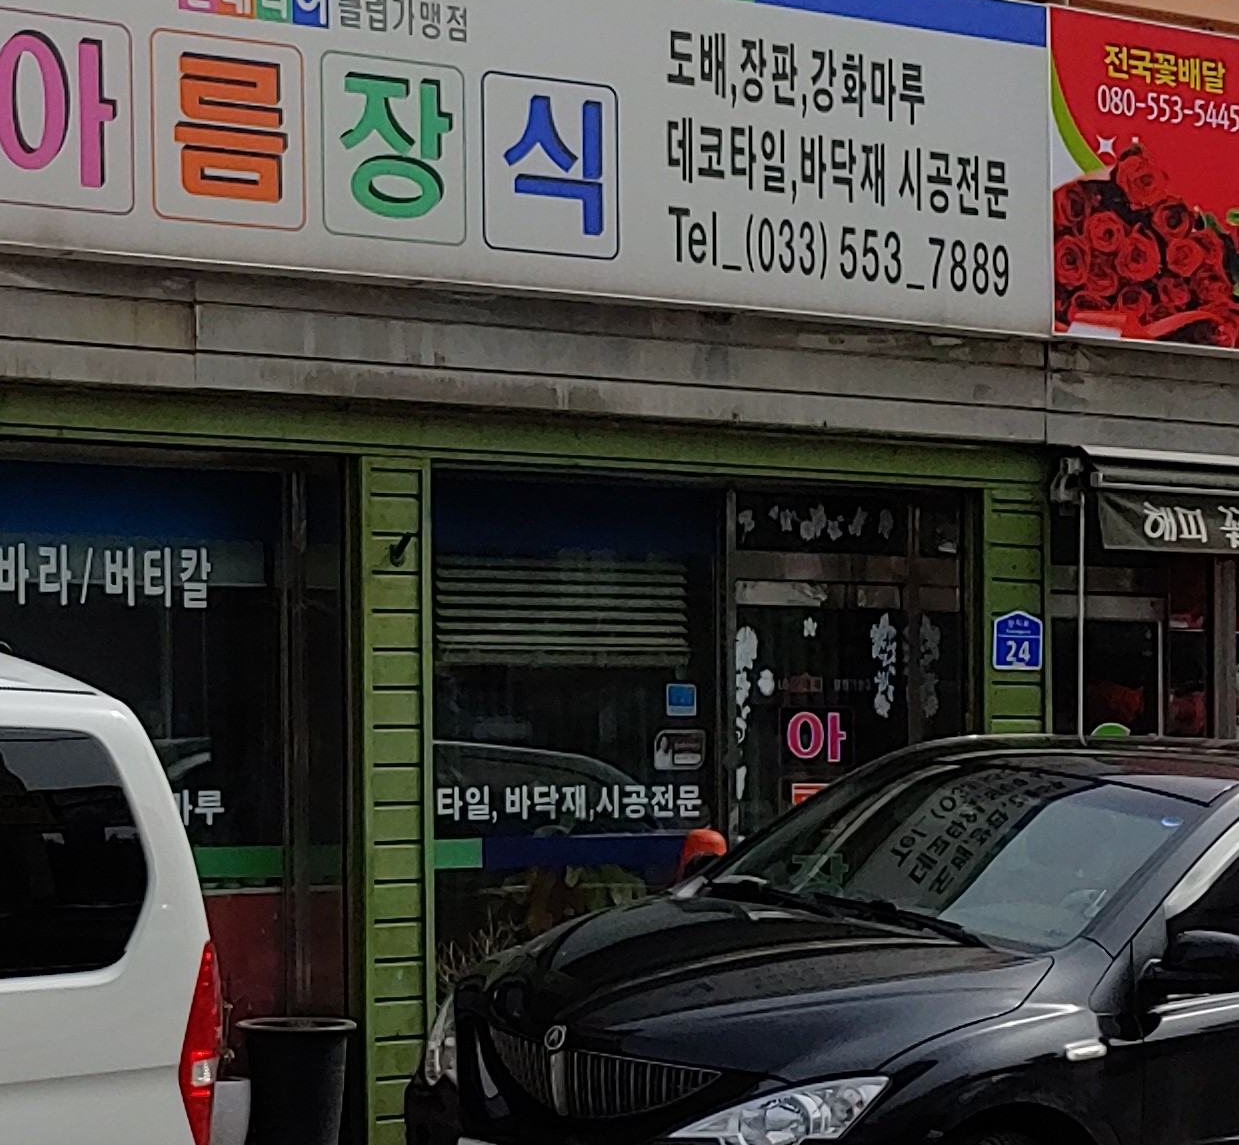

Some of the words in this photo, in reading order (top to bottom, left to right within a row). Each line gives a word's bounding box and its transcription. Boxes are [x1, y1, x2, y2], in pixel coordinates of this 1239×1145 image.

[1103, 44, 1226, 95] 전국꽃배달
[1097, 84, 1239, 133] 080-553-5445
[897, 147, 1010, 220] 시공전문
[1143, 501, 1208, 543] 해피
[1006, 640, 1031, 662] 24
